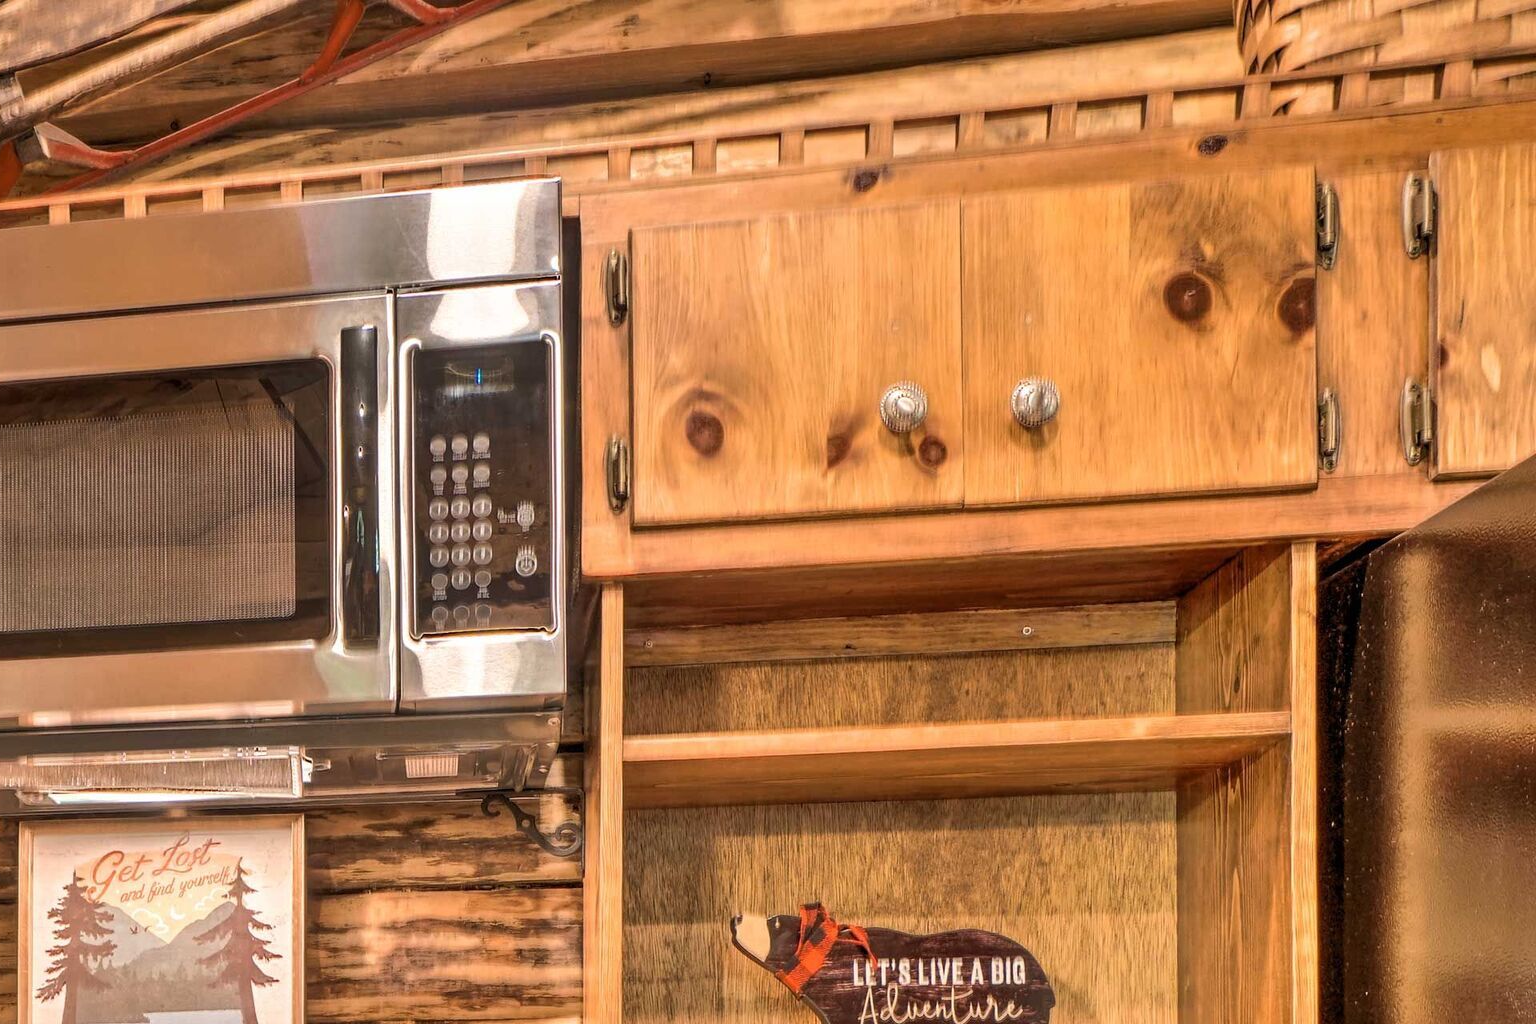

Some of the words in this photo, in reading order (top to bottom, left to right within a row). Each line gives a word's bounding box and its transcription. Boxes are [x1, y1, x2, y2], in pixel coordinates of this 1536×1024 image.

[86, 850, 153, 904] Get
[151, 831, 221, 877] Lost
[120, 886, 145, 903] and
[147, 877, 175, 904] find
[918, 957, 965, 986] LIVE
[970, 957, 984, 985] A
[991, 955, 1027, 986] BIG
